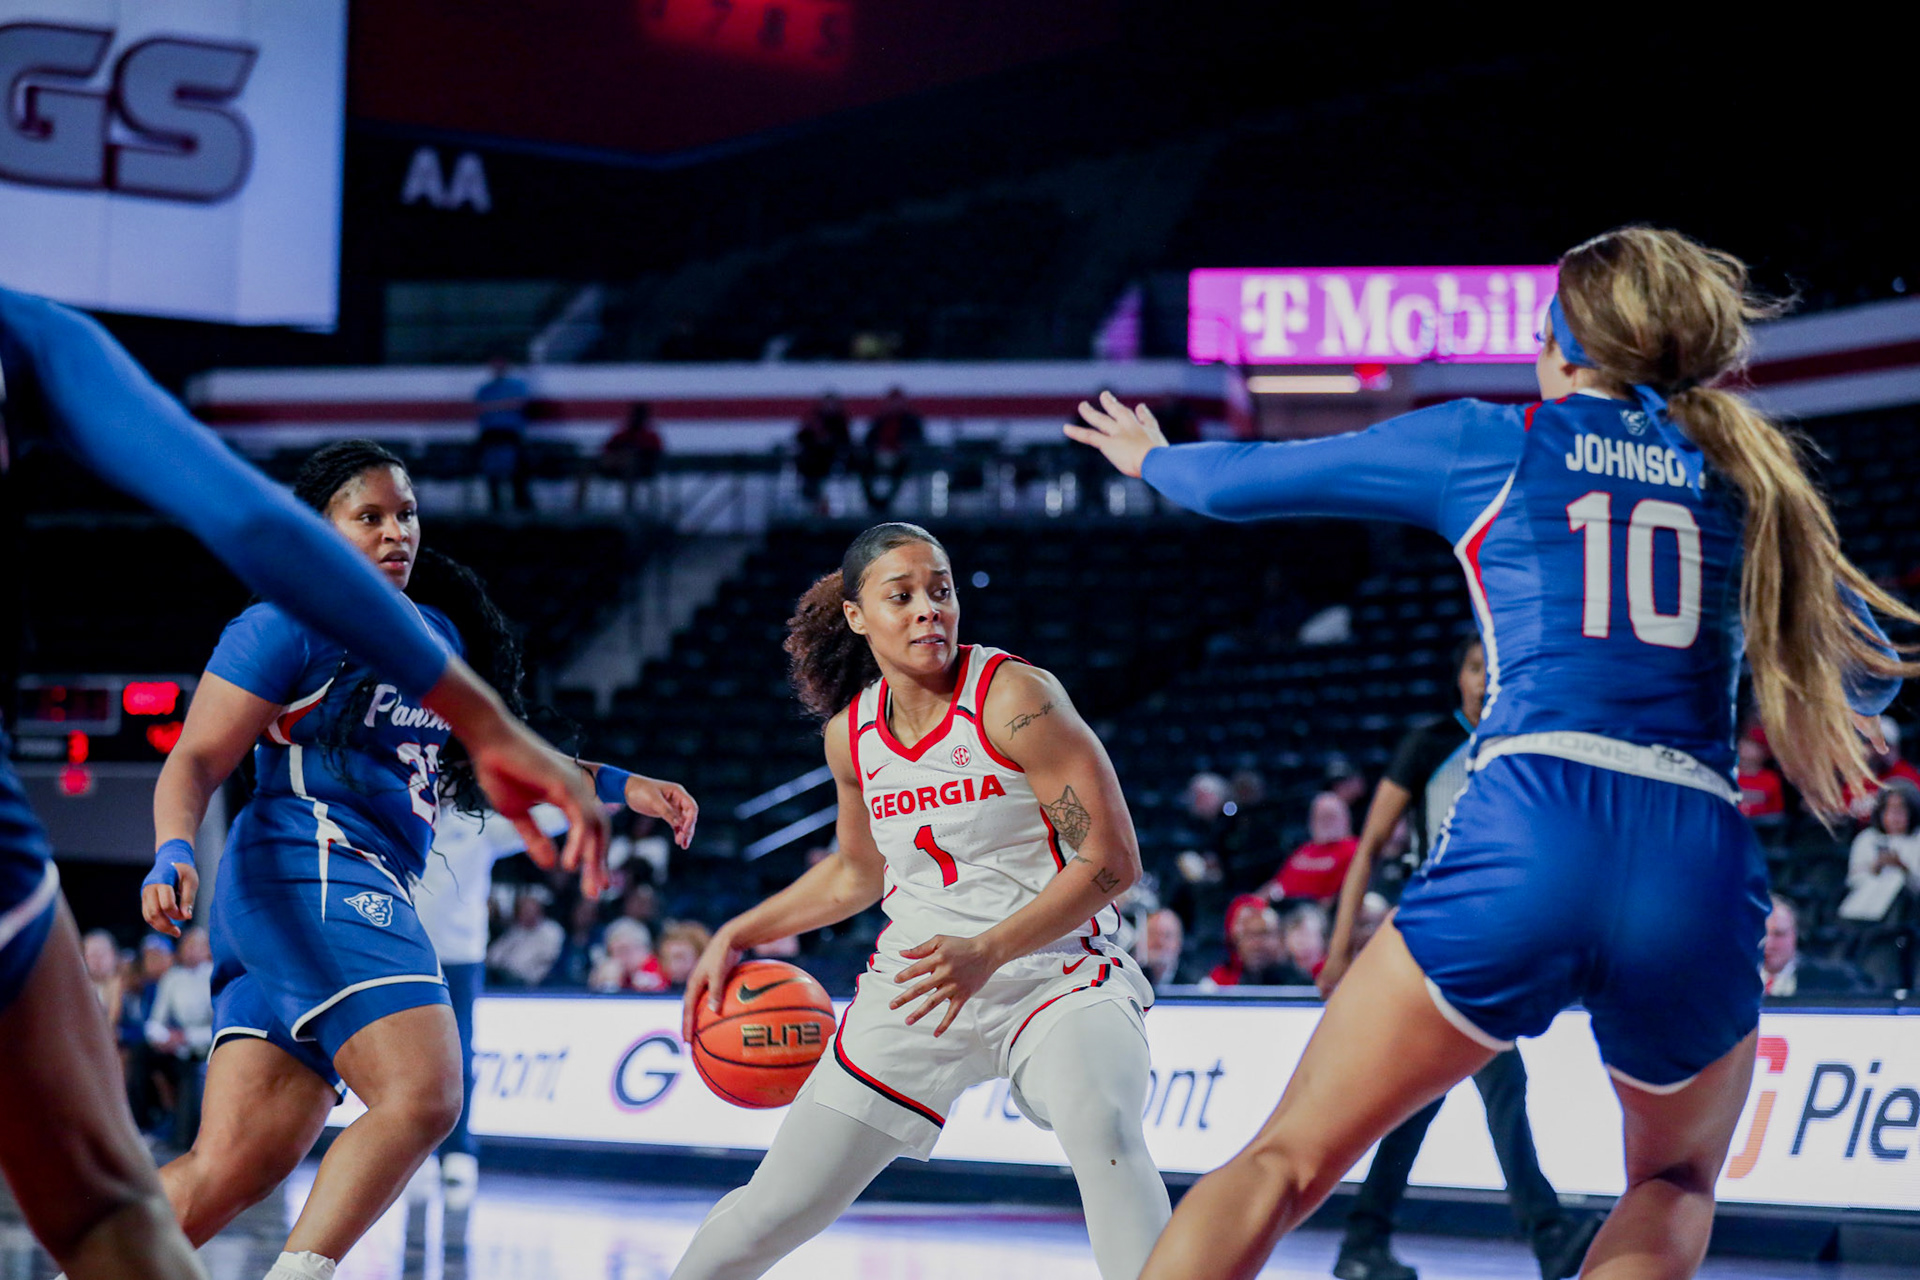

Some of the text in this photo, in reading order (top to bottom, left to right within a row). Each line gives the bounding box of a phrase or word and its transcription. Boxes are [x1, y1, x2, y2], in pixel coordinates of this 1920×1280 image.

[0, 20, 260, 204] GS
[402, 147, 491, 213] AA
[1317, 272, 1556, 357] Mobil
[1566, 490, 1703, 649] 10
[952, 747, 971, 766] SEC
[871, 774, 1006, 820] GEORGIA
[914, 824, 958, 888] 1
[741, 1022, 821, 1047] ELITE
[613, 1031, 684, 1112] G
[1790, 1061, 1920, 1160] Pie
